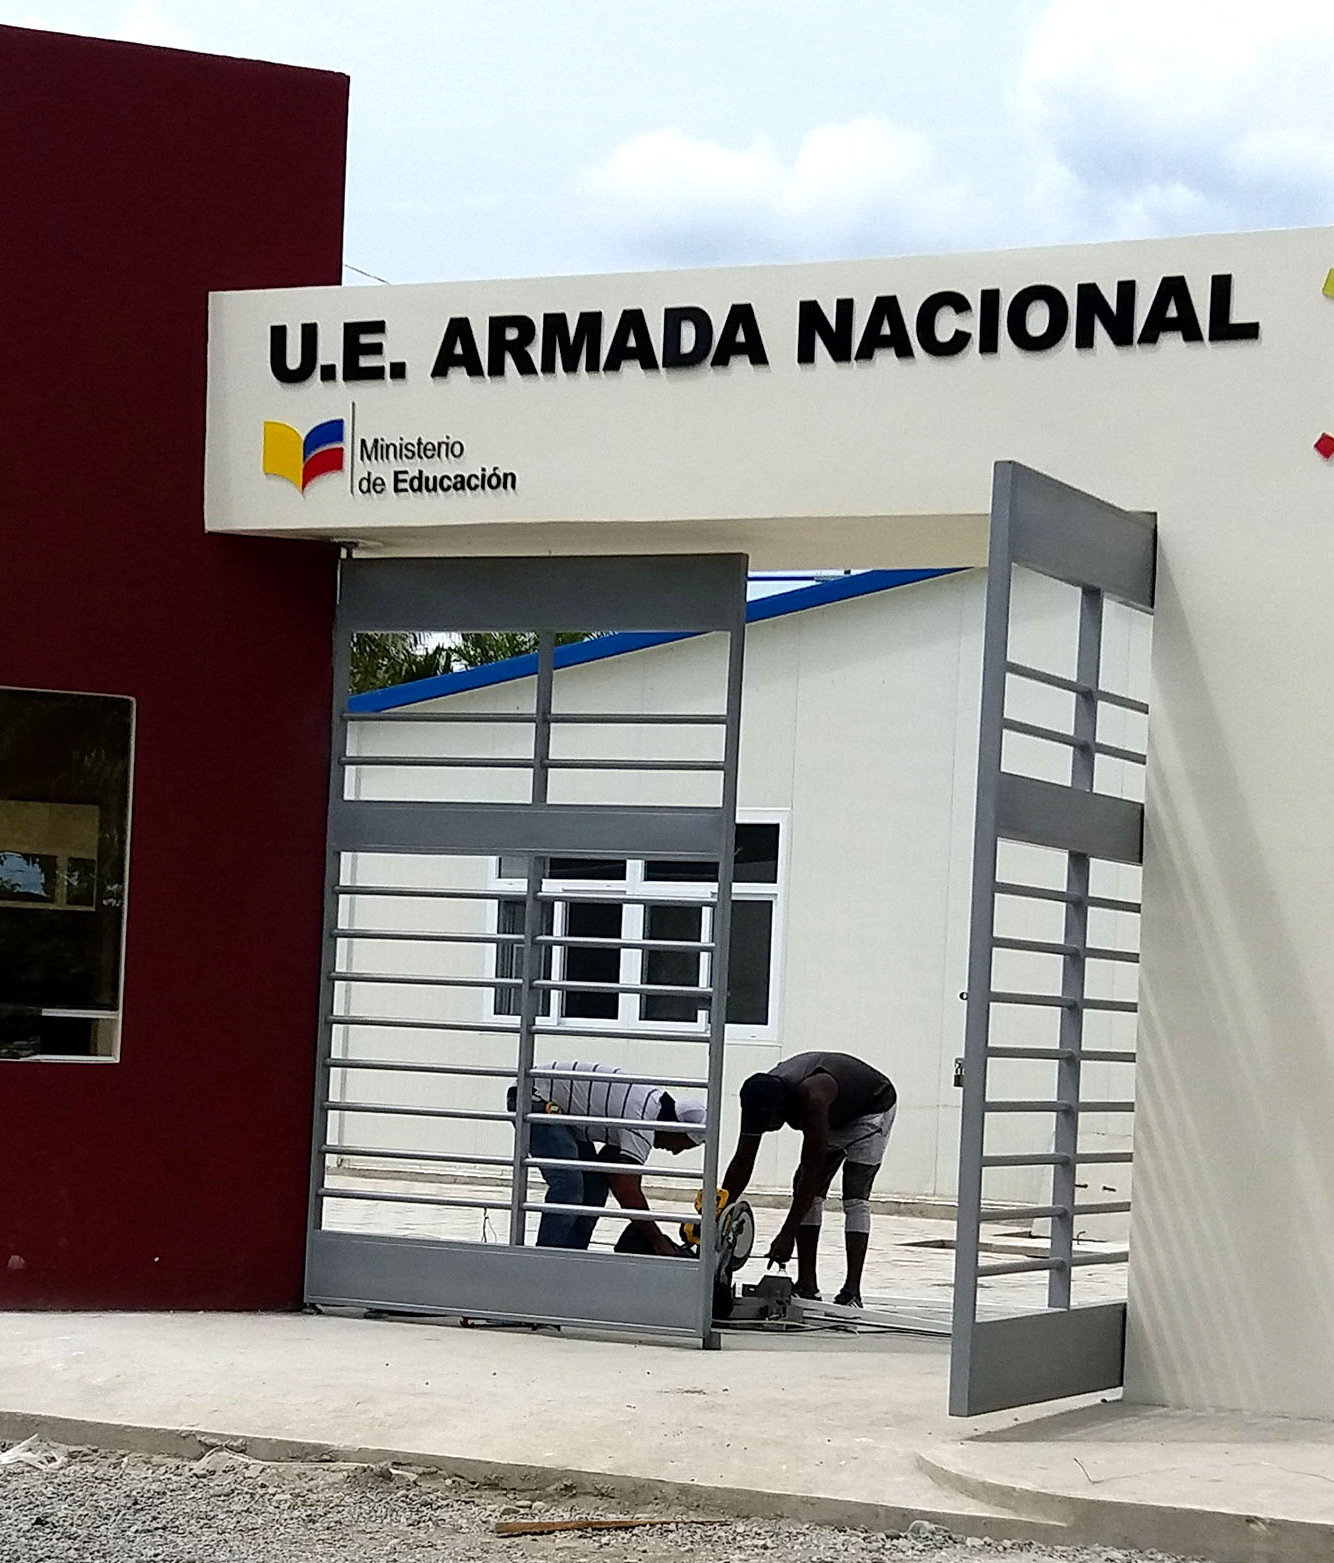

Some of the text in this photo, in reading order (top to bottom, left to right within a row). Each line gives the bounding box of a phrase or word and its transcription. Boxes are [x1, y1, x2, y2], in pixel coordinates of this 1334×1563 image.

[269, 274, 1259, 384] U.E. ARMADA NACIONAL
[359, 435, 465, 462] Ministerio
[358, 466, 517, 494] de Educación
